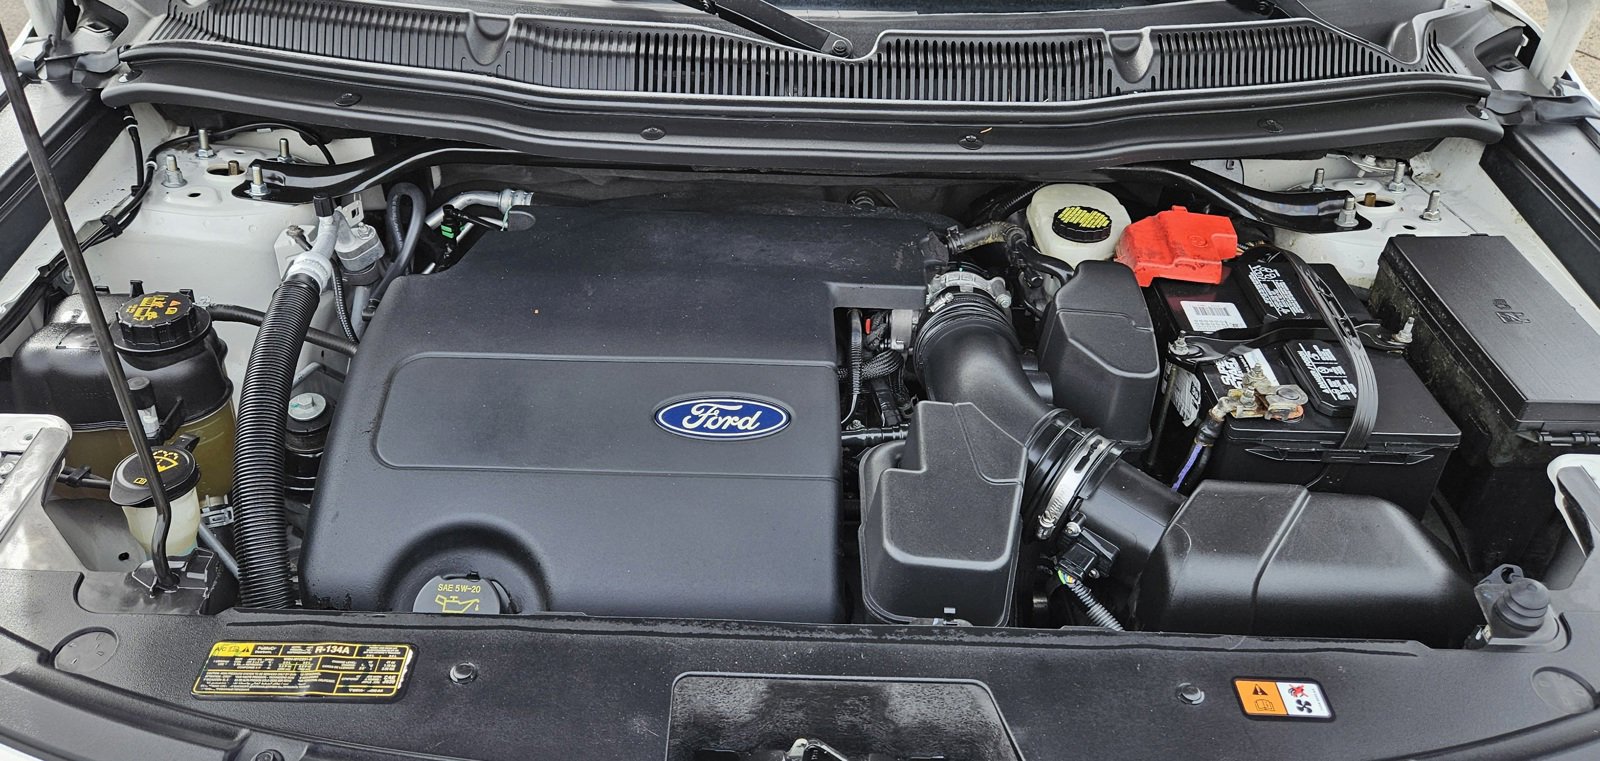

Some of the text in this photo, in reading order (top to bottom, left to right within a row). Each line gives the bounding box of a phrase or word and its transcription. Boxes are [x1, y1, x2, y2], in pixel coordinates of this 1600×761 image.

[1215, 359, 1232, 386] SUPE
[682, 403, 763, 430] Ford
[437, 583, 481, 593] SAE 5W-20
[314, 645, 350, 655] R-134A
